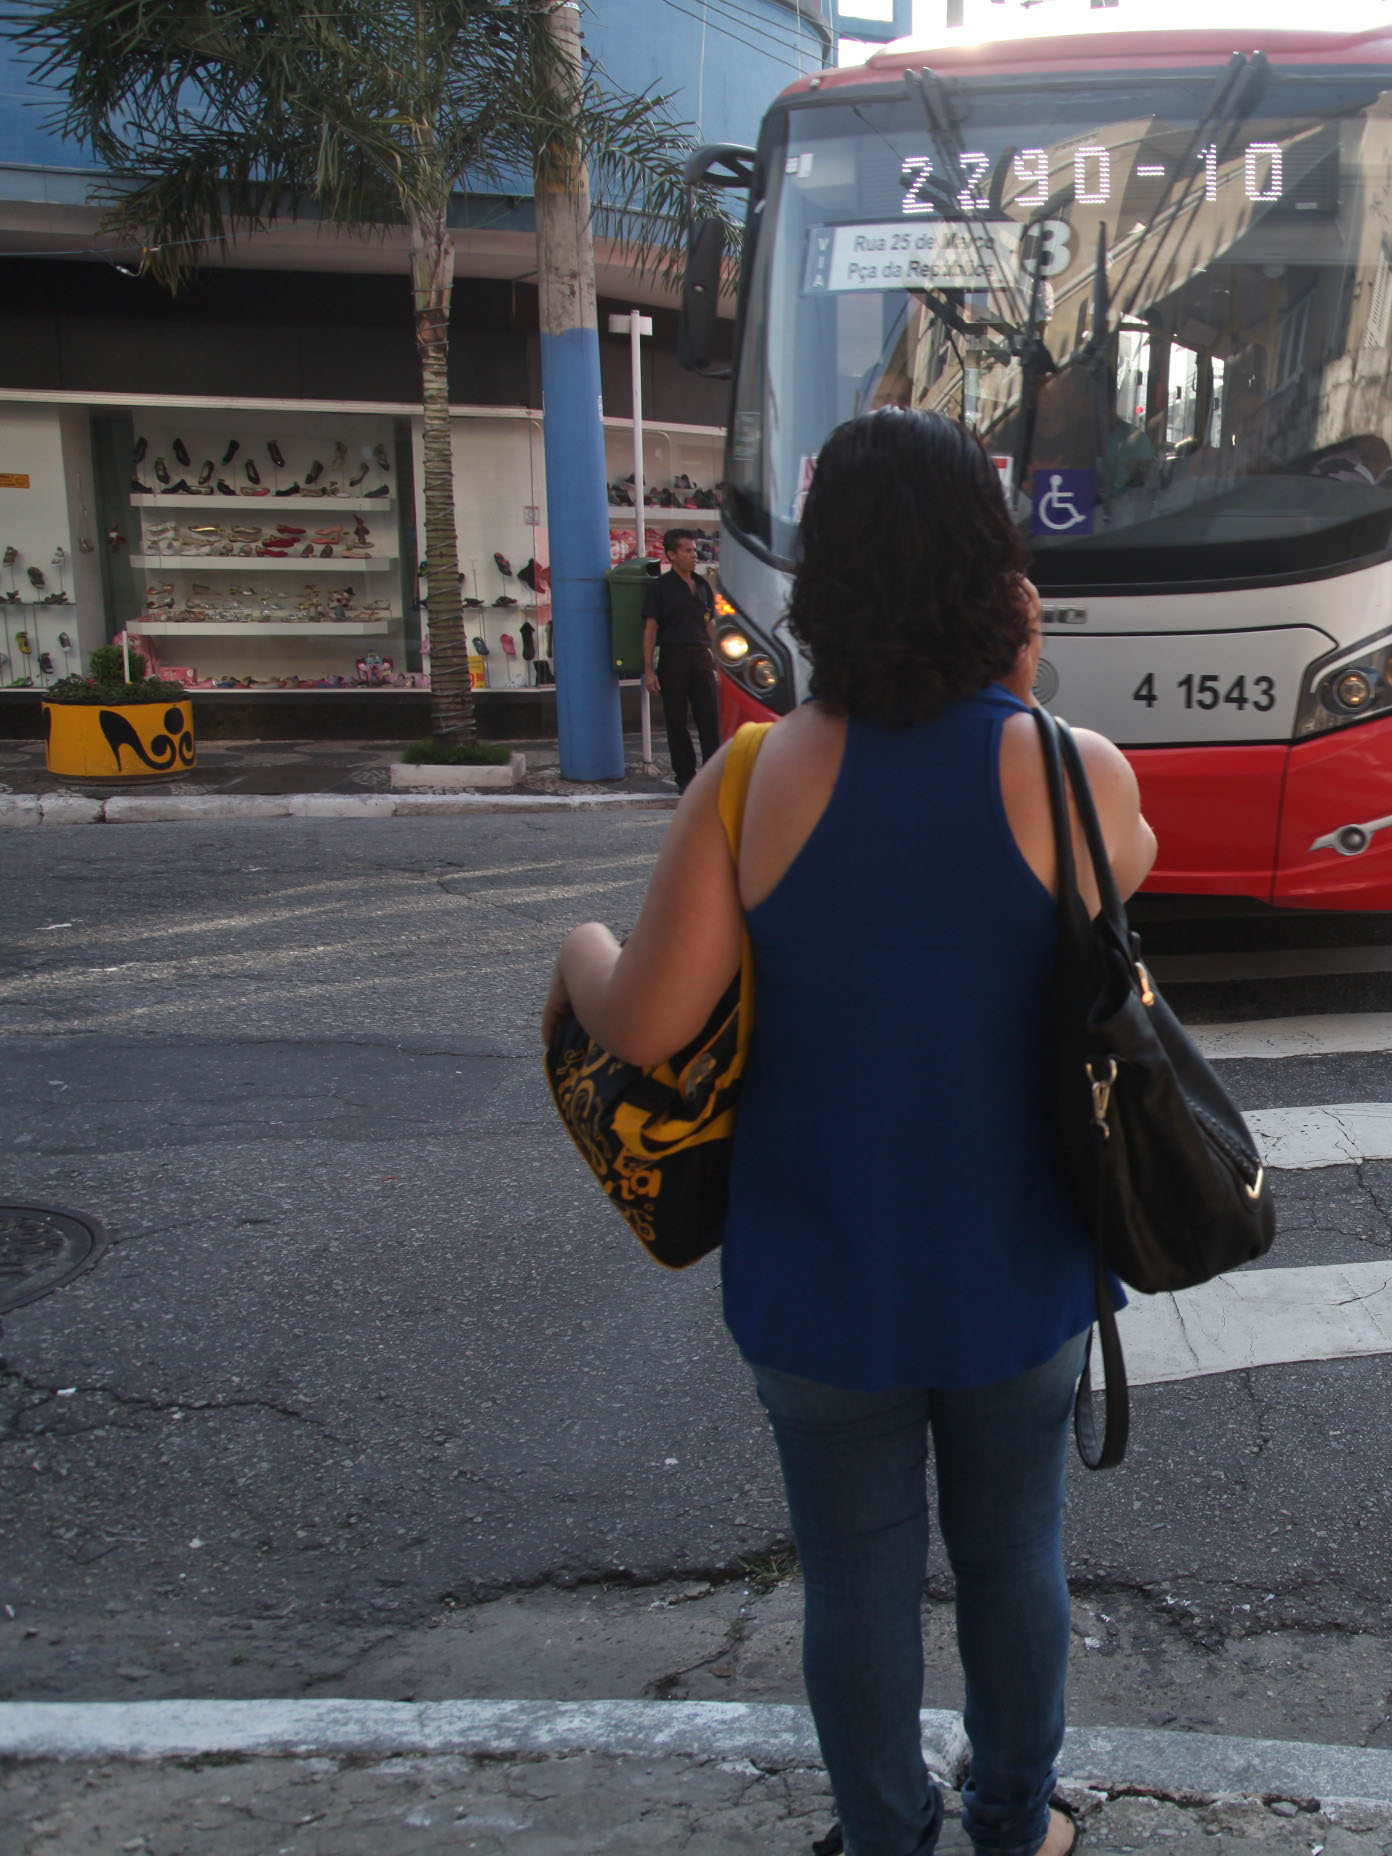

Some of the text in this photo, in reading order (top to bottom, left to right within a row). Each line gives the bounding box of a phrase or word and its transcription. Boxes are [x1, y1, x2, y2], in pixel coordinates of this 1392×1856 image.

[853, 231, 995, 251] Rua 25 de Maço
[1023, 219, 1071, 277] 3
[846, 262, 878, 284] Pça
[882, 259, 903, 279] da
[1132, 672, 1277, 712] 4 1543
